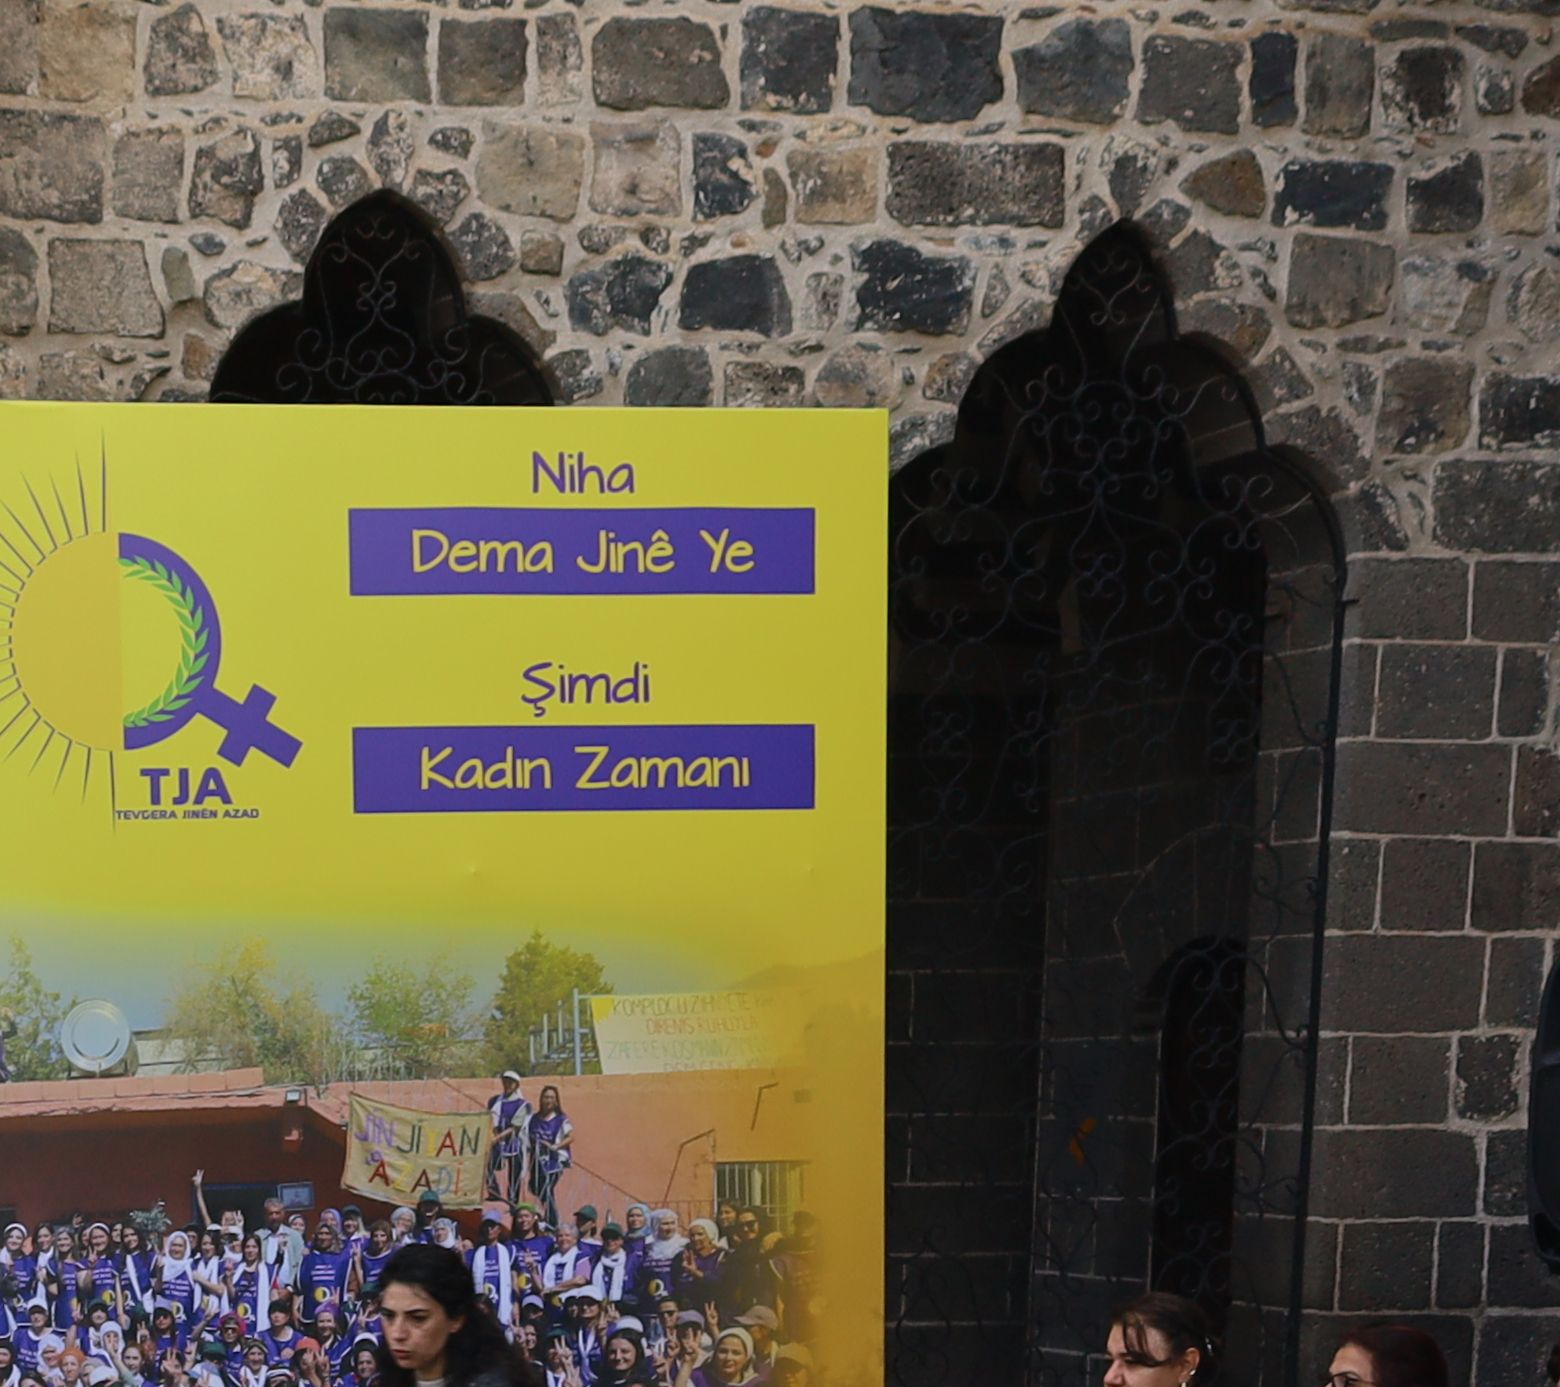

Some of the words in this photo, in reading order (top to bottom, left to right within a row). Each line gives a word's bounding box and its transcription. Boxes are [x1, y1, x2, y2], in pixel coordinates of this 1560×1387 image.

[532, 453, 635, 493] Niha
[410, 528, 555, 574] Dema
[575, 529, 676, 574] Jinê
[699, 528, 756, 574] Ye
[521, 661, 651, 719] Şimdi
[140, 767, 233, 806] TJA
[419, 746, 553, 791] Kadın
[574, 745, 751, 790] Zamanı
[115, 809, 177, 820] TEVGERA
[223, 808, 260, 819] AZAD
